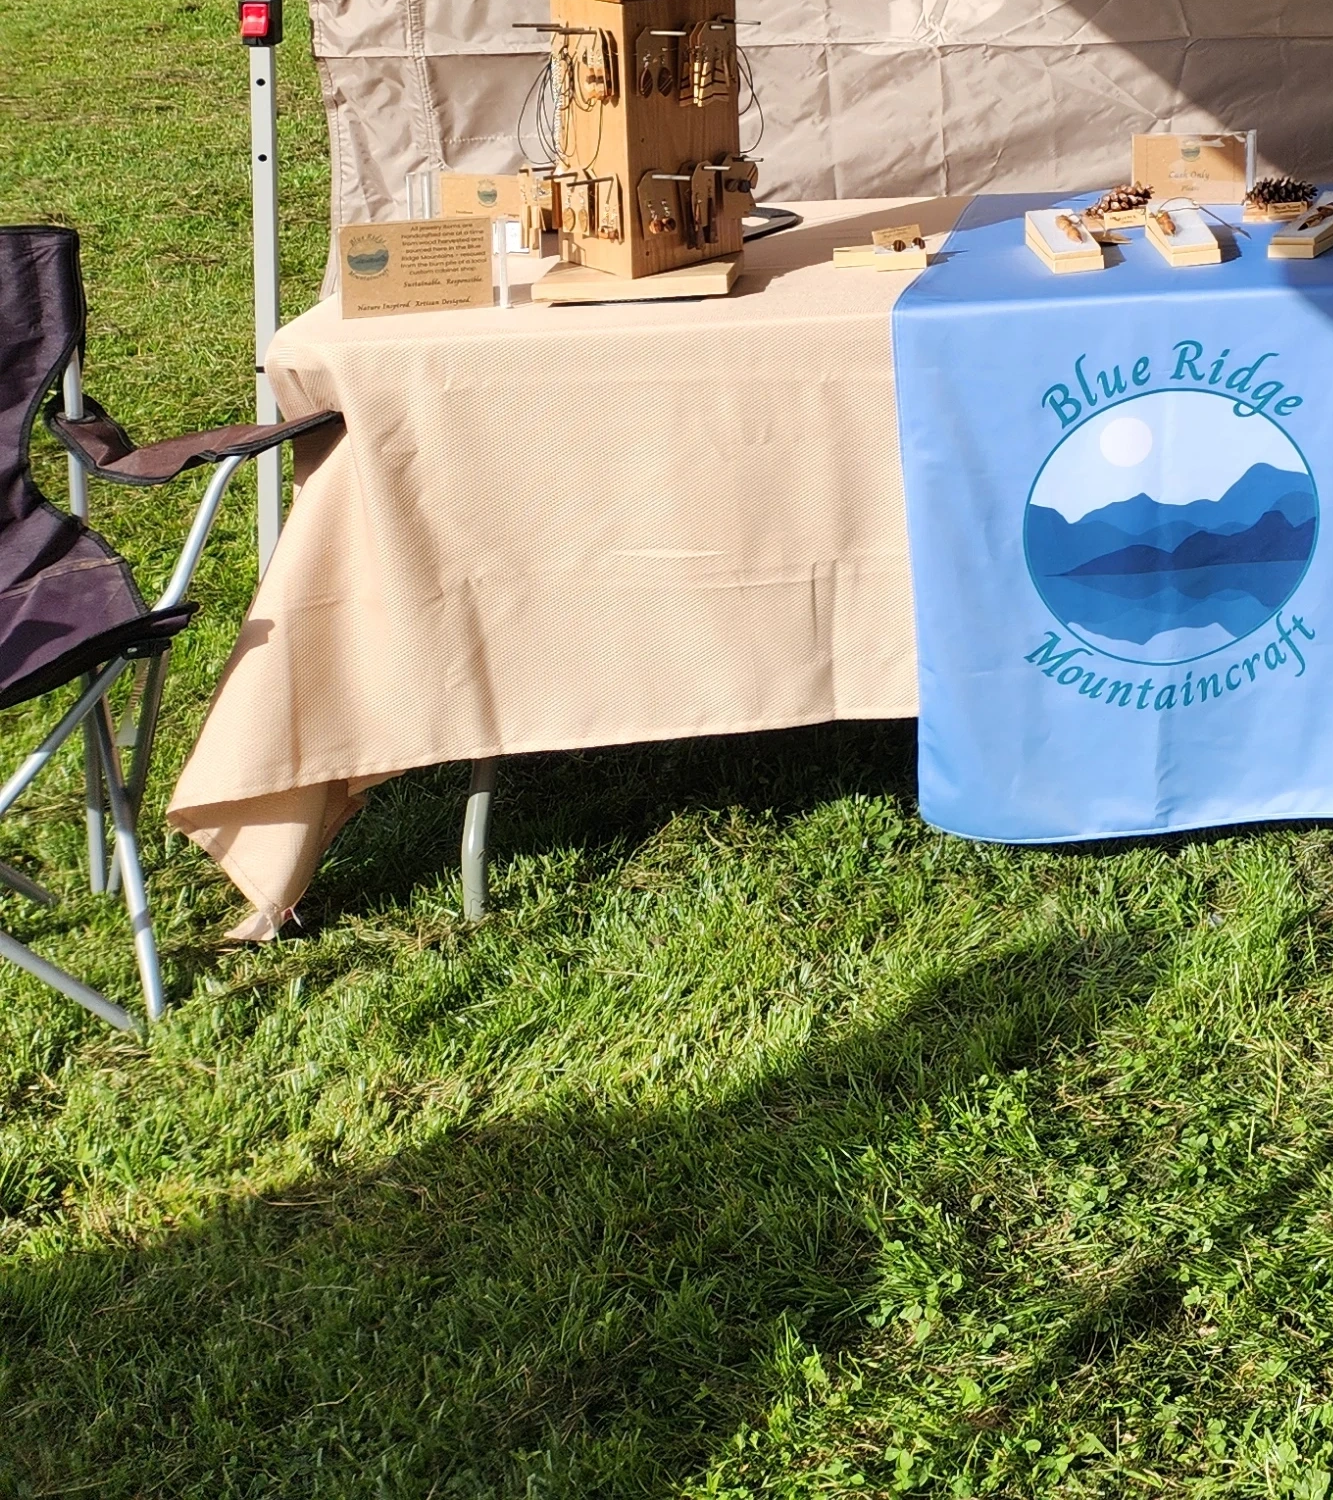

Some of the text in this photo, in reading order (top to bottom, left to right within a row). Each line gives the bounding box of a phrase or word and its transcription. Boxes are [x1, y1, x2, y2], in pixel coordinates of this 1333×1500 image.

[1190, 169, 1210, 180] Only
[1042, 339, 1304, 429] Blue Ridge
[1023, 610, 1316, 712] Mountaincraft
